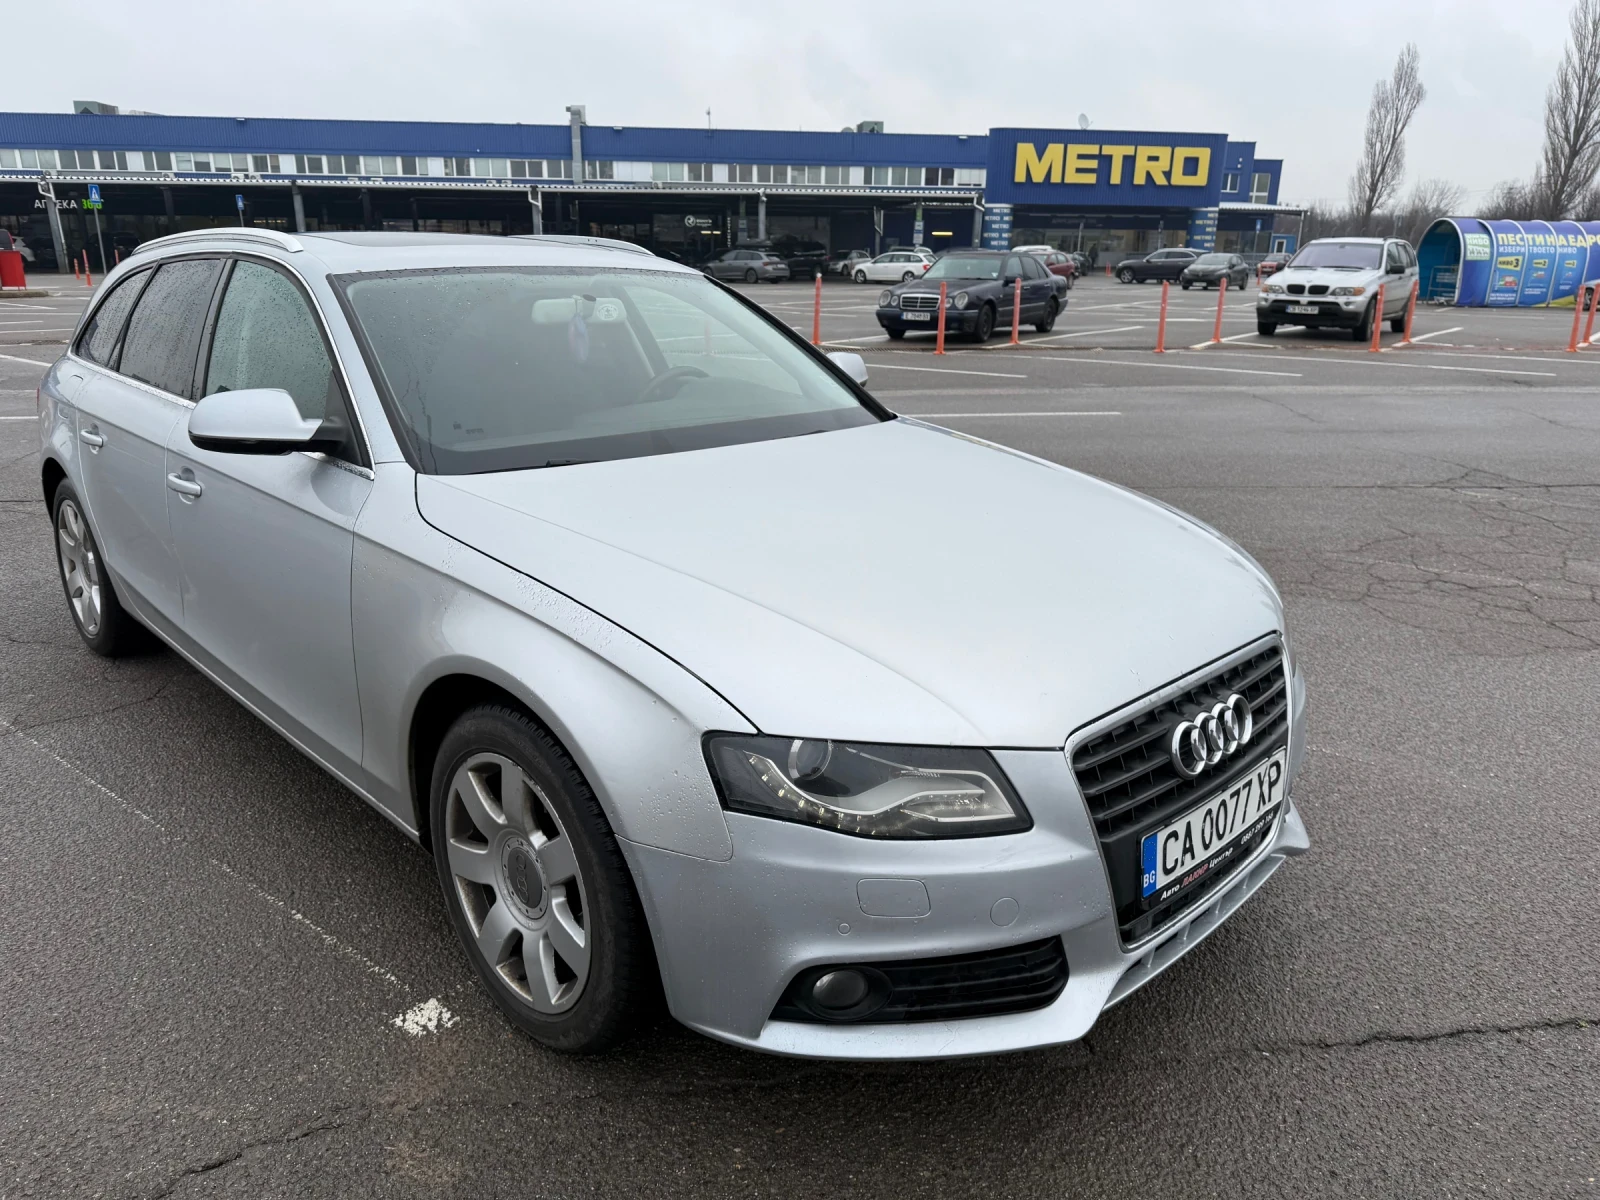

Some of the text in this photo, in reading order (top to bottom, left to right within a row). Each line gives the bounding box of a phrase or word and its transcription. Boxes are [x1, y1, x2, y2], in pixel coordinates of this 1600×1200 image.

[1014, 142, 1211, 187] METRO
[34, 199, 78, 209] АПЕКА
[1499, 245, 1578, 254] ИЗБЕРИ ТВОЕТО НИВО
[1513, 258, 1520, 268] 3
[1162, 760, 1281, 877] CA 0077 XP
[1143, 870, 1155, 888] BG
[1160, 884, 1180, 901] Авто
